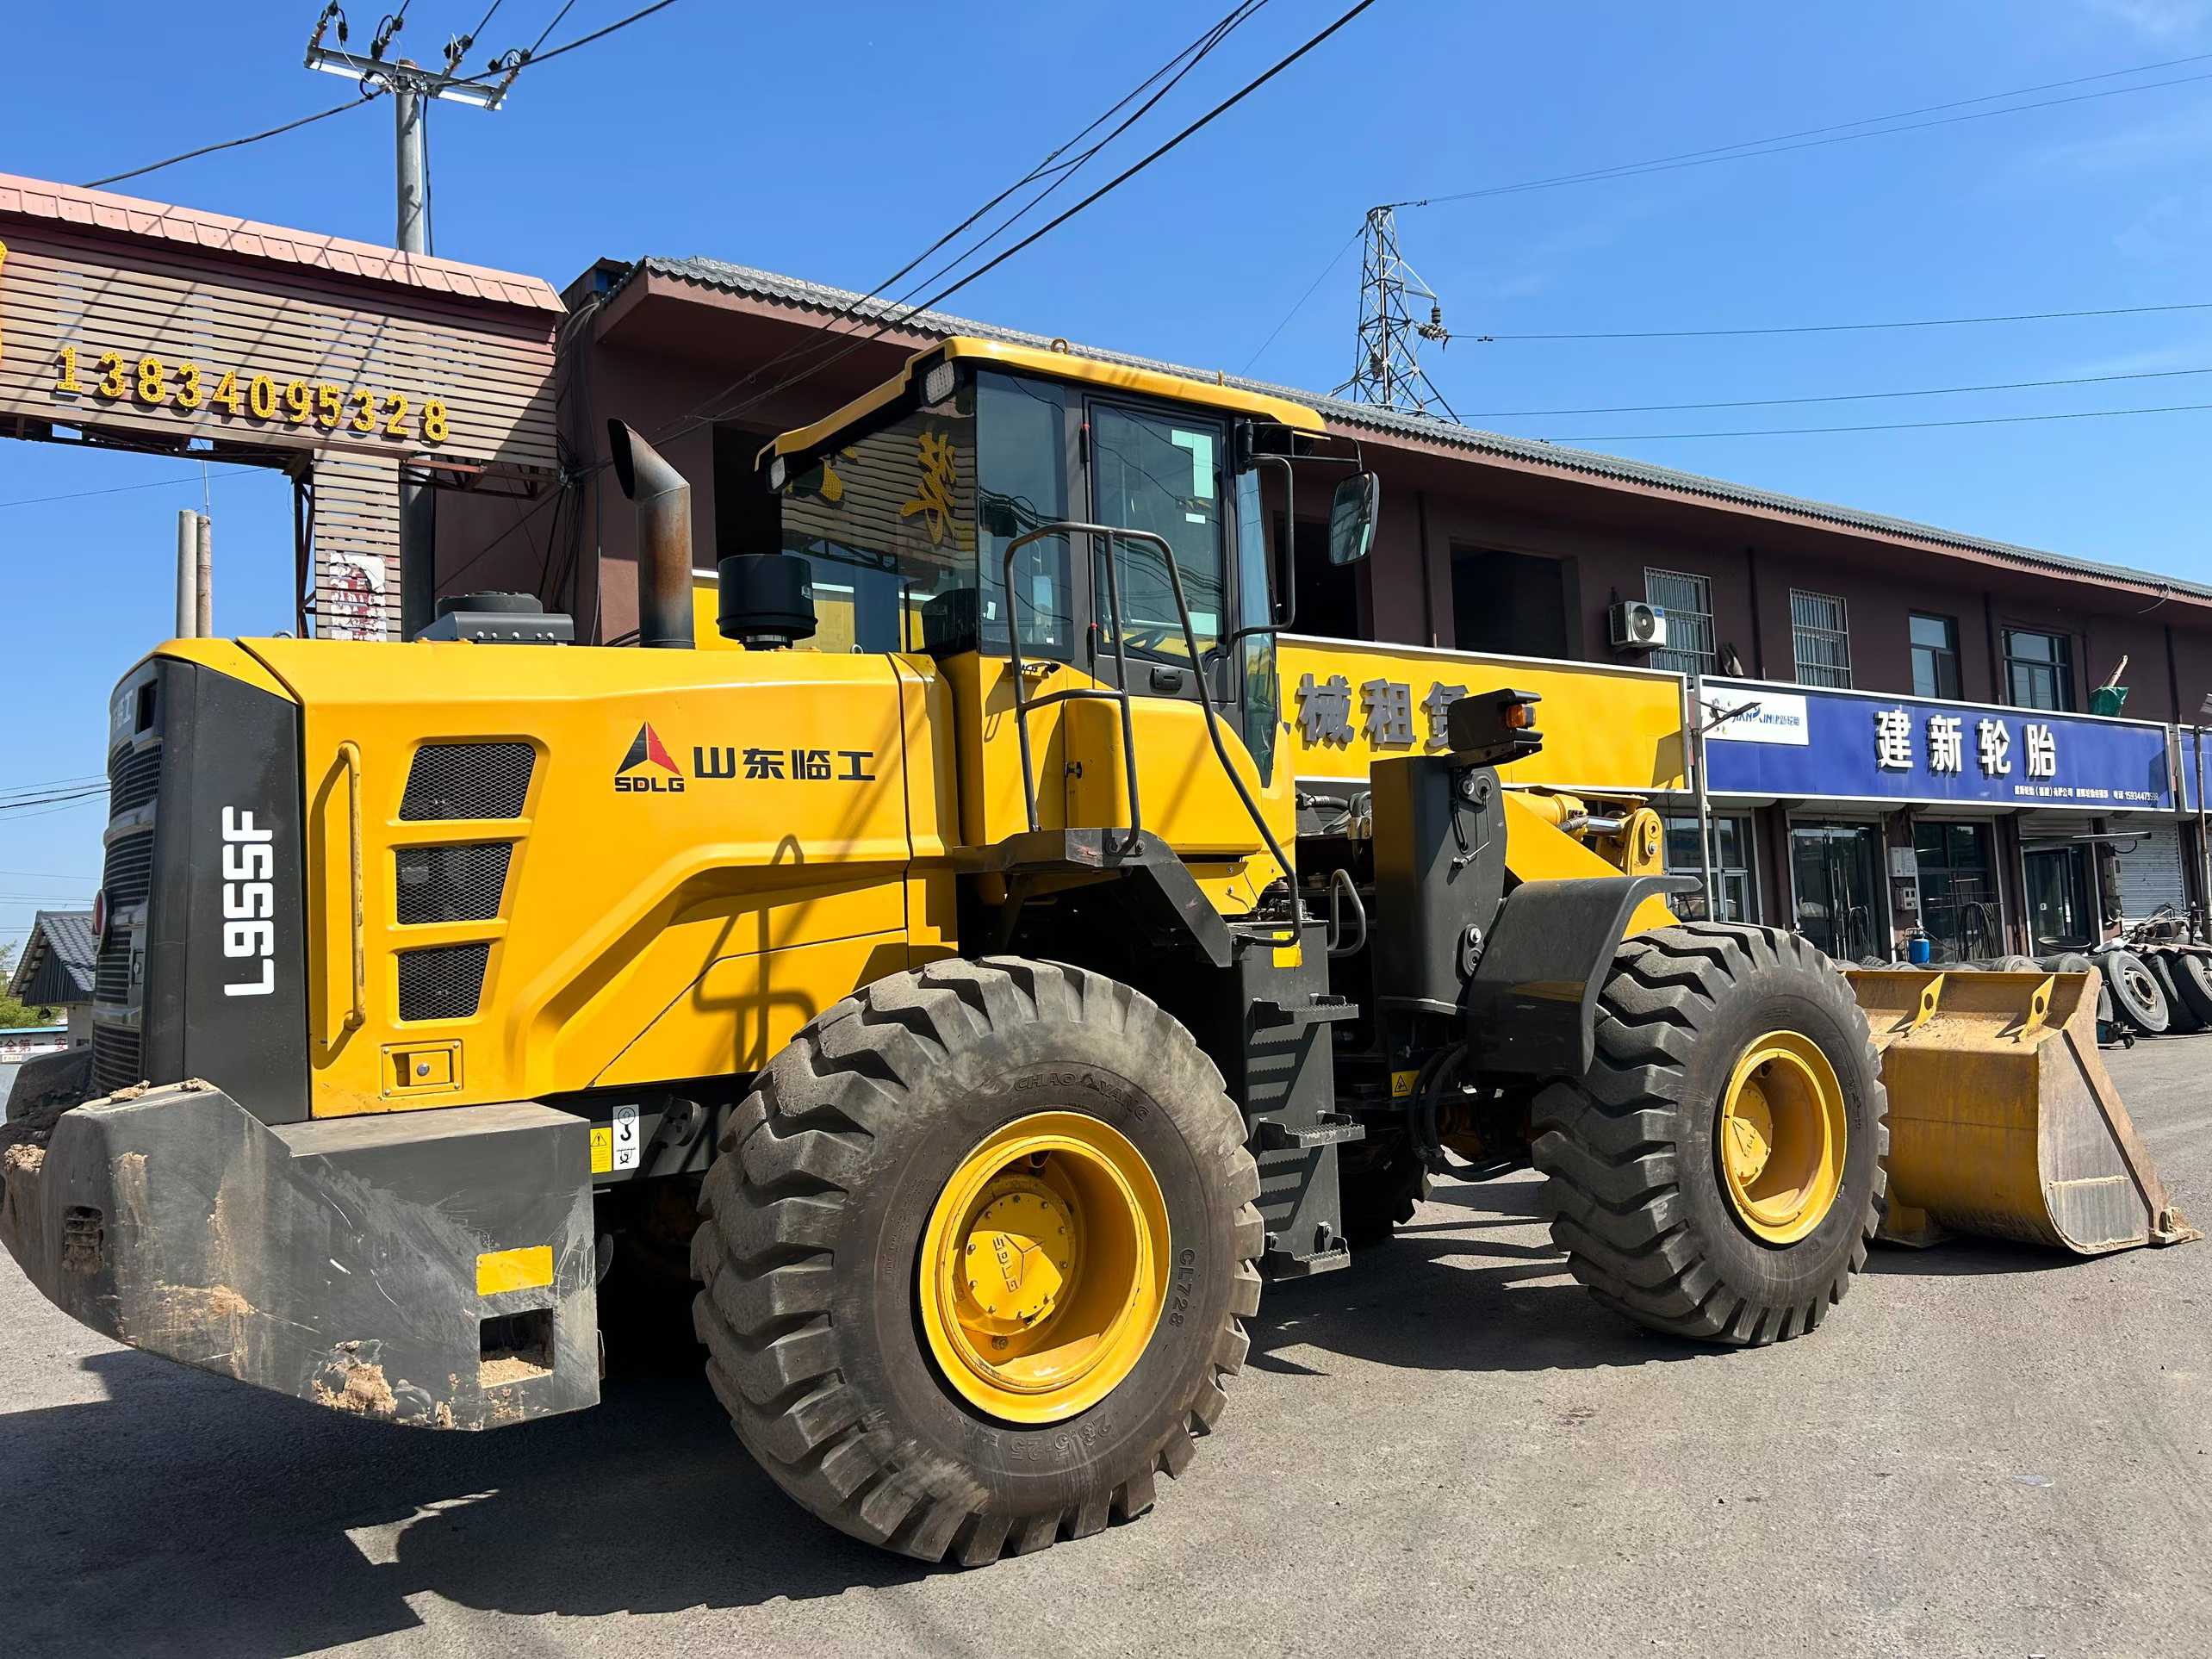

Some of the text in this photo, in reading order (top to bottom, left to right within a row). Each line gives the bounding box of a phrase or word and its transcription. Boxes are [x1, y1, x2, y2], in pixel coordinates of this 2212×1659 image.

[55, 345, 450, 442] 13834095328
[1276, 674, 1469, 755] 械租赁
[1876, 709, 2057, 777] 建新轮胎
[614, 776, 685, 792] SDLG
[693, 746, 876, 781] 山东临工
[221, 805, 275, 997] L955F
[0, 1038, 47, 1053] 全第一
[1169, 1247, 1196, 1327] CL728
